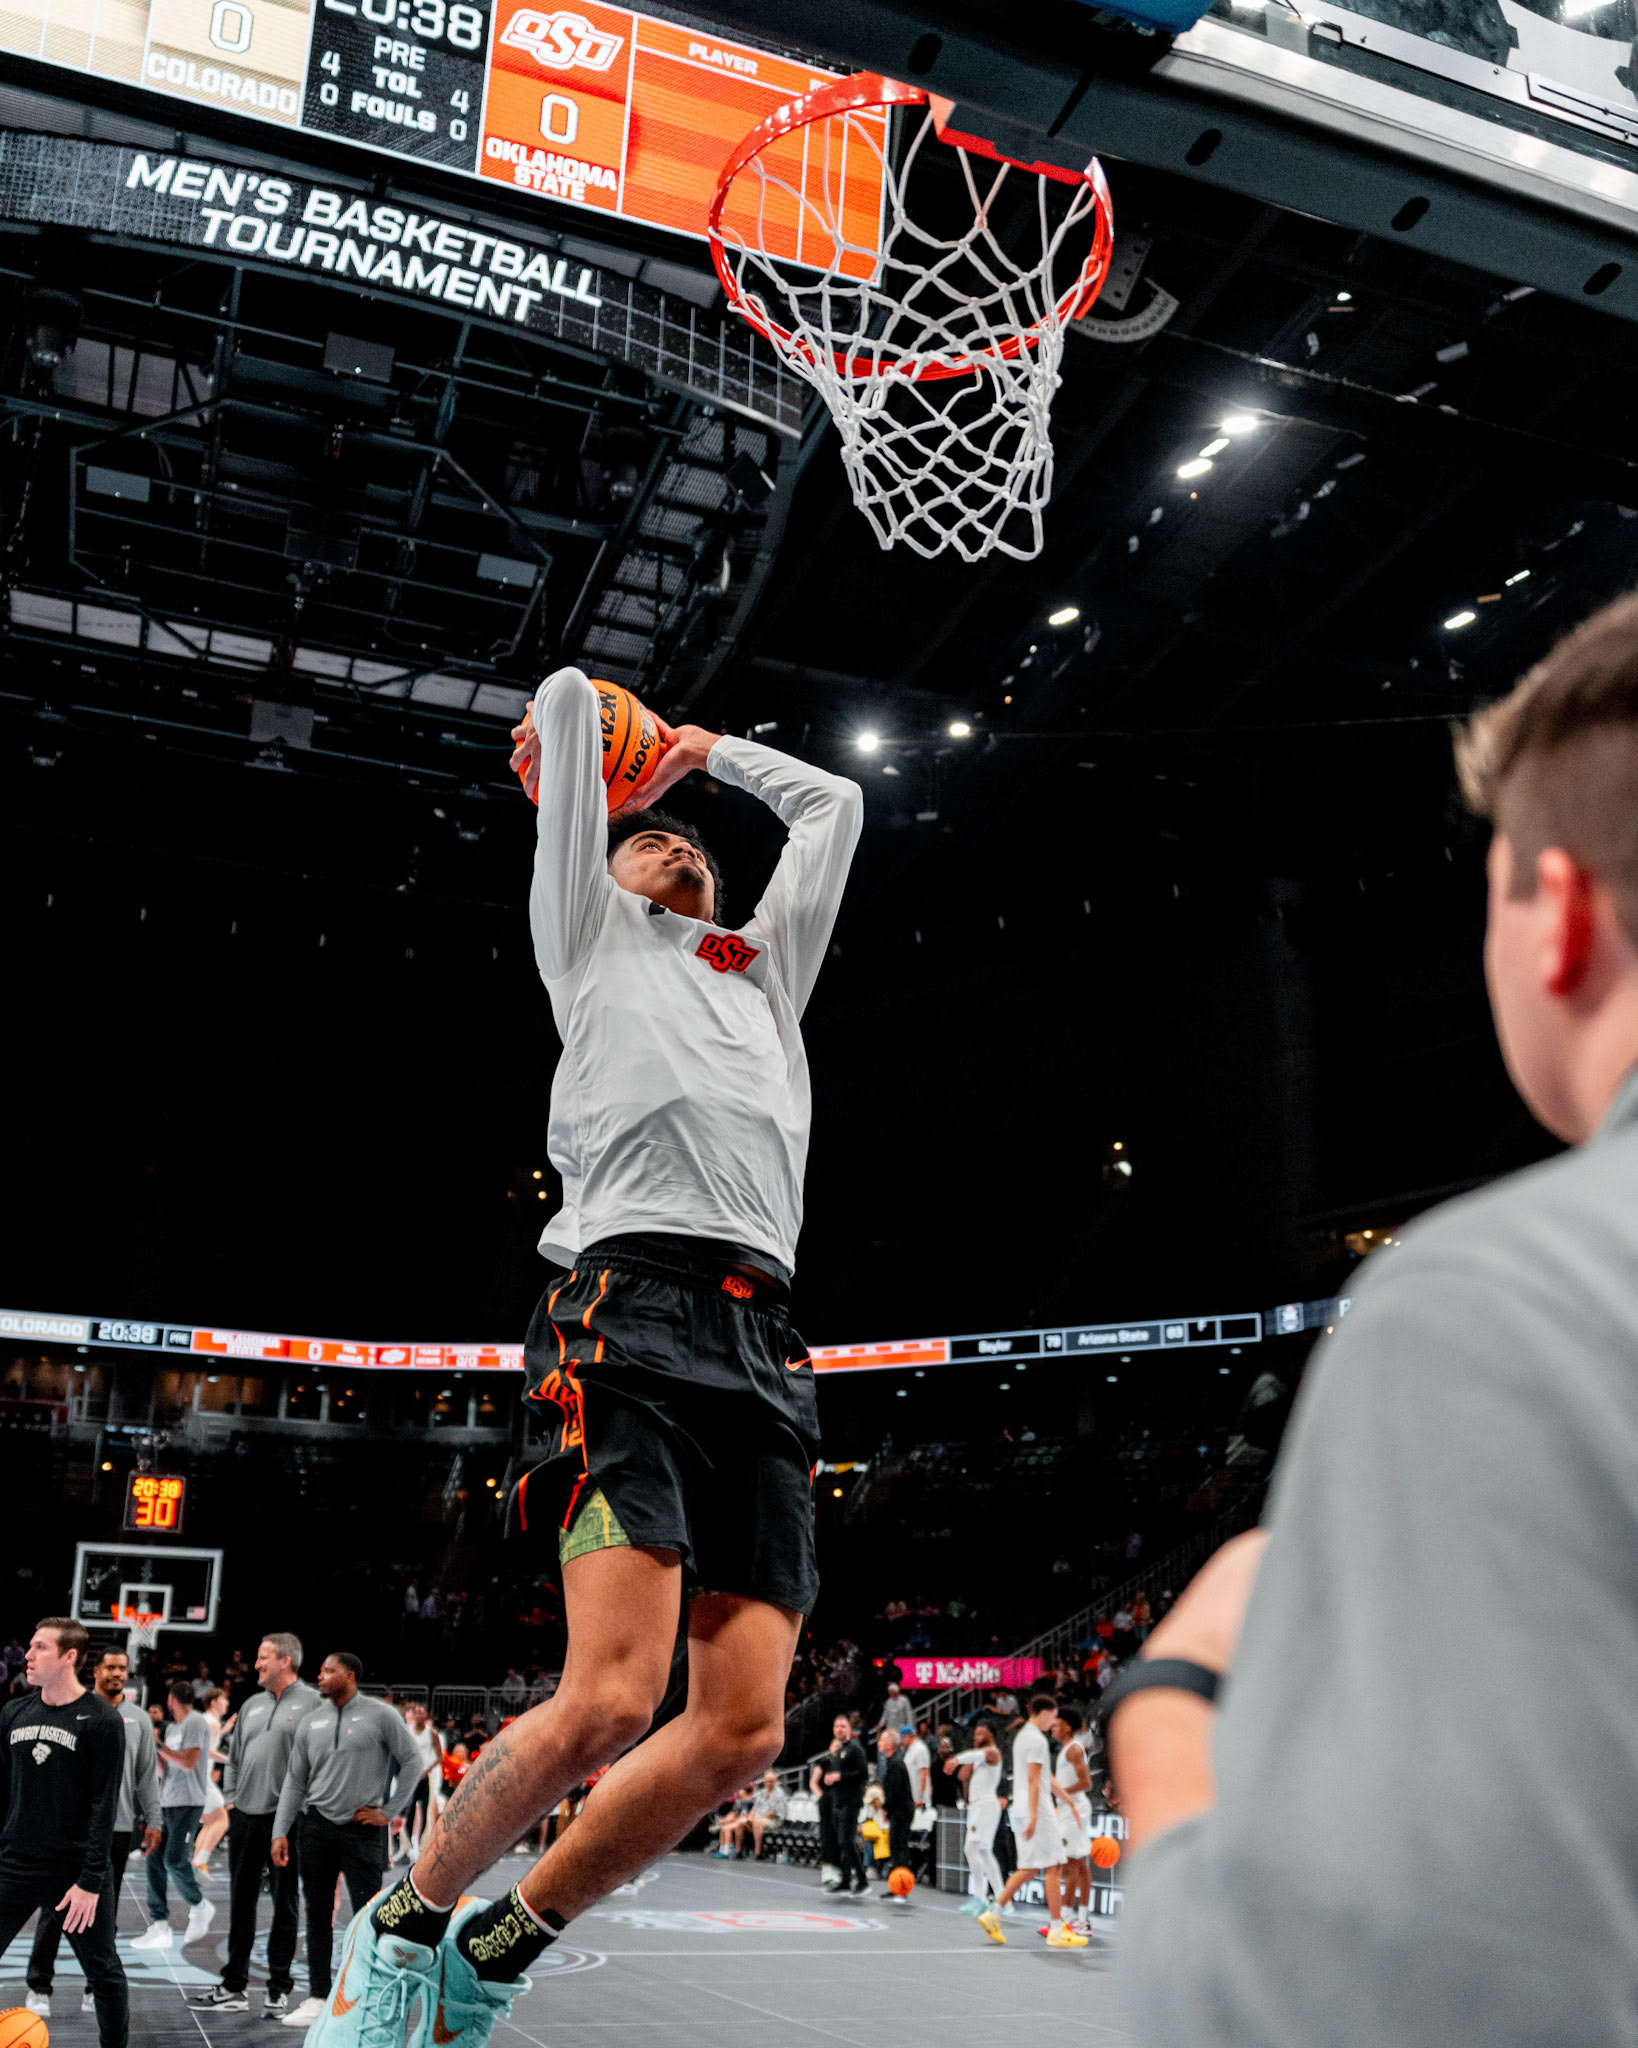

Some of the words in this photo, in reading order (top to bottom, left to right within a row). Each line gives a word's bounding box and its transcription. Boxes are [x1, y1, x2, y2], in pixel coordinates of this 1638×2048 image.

[209, 0, 254, 54] 0
[324, 0, 483, 50] 0:38
[499, 7, 624, 71] OSU
[373, 35, 427, 71] PRE
[688, 42, 758, 75] PLAYER
[147, 51, 298, 115] COLORADO
[320, 51, 341, 77] 4
[372, 65, 422, 99] TOL
[450, 89, 470, 115] 4
[320, 83, 339, 106] 0
[351, 90, 437, 133] FOULS
[449, 118, 467, 140] 0
[539, 93, 579, 145] 0
[485, 137, 617, 191] OKLAHOMA
[514, 164, 585, 201] STATE
[126, 154, 293, 216] MEN'S
[302, 190, 602, 307] BASKETBALL
[200, 208, 542, 323] TOURNAMENT
[599, 690, 618, 752] NCAA
[695, 933, 760, 973] OSU
[721, 1275, 754, 1299] OSU
[0, 1316, 84, 1337] OLORADO
[98, 1321, 157, 1344] 20:38
[132, 1477, 183, 1499] 20:38
[135, 1497, 177, 1527] 30
[10, 1725, 40, 1745] COWBOY
[39, 1725, 77, 1751] BASKETBALL
